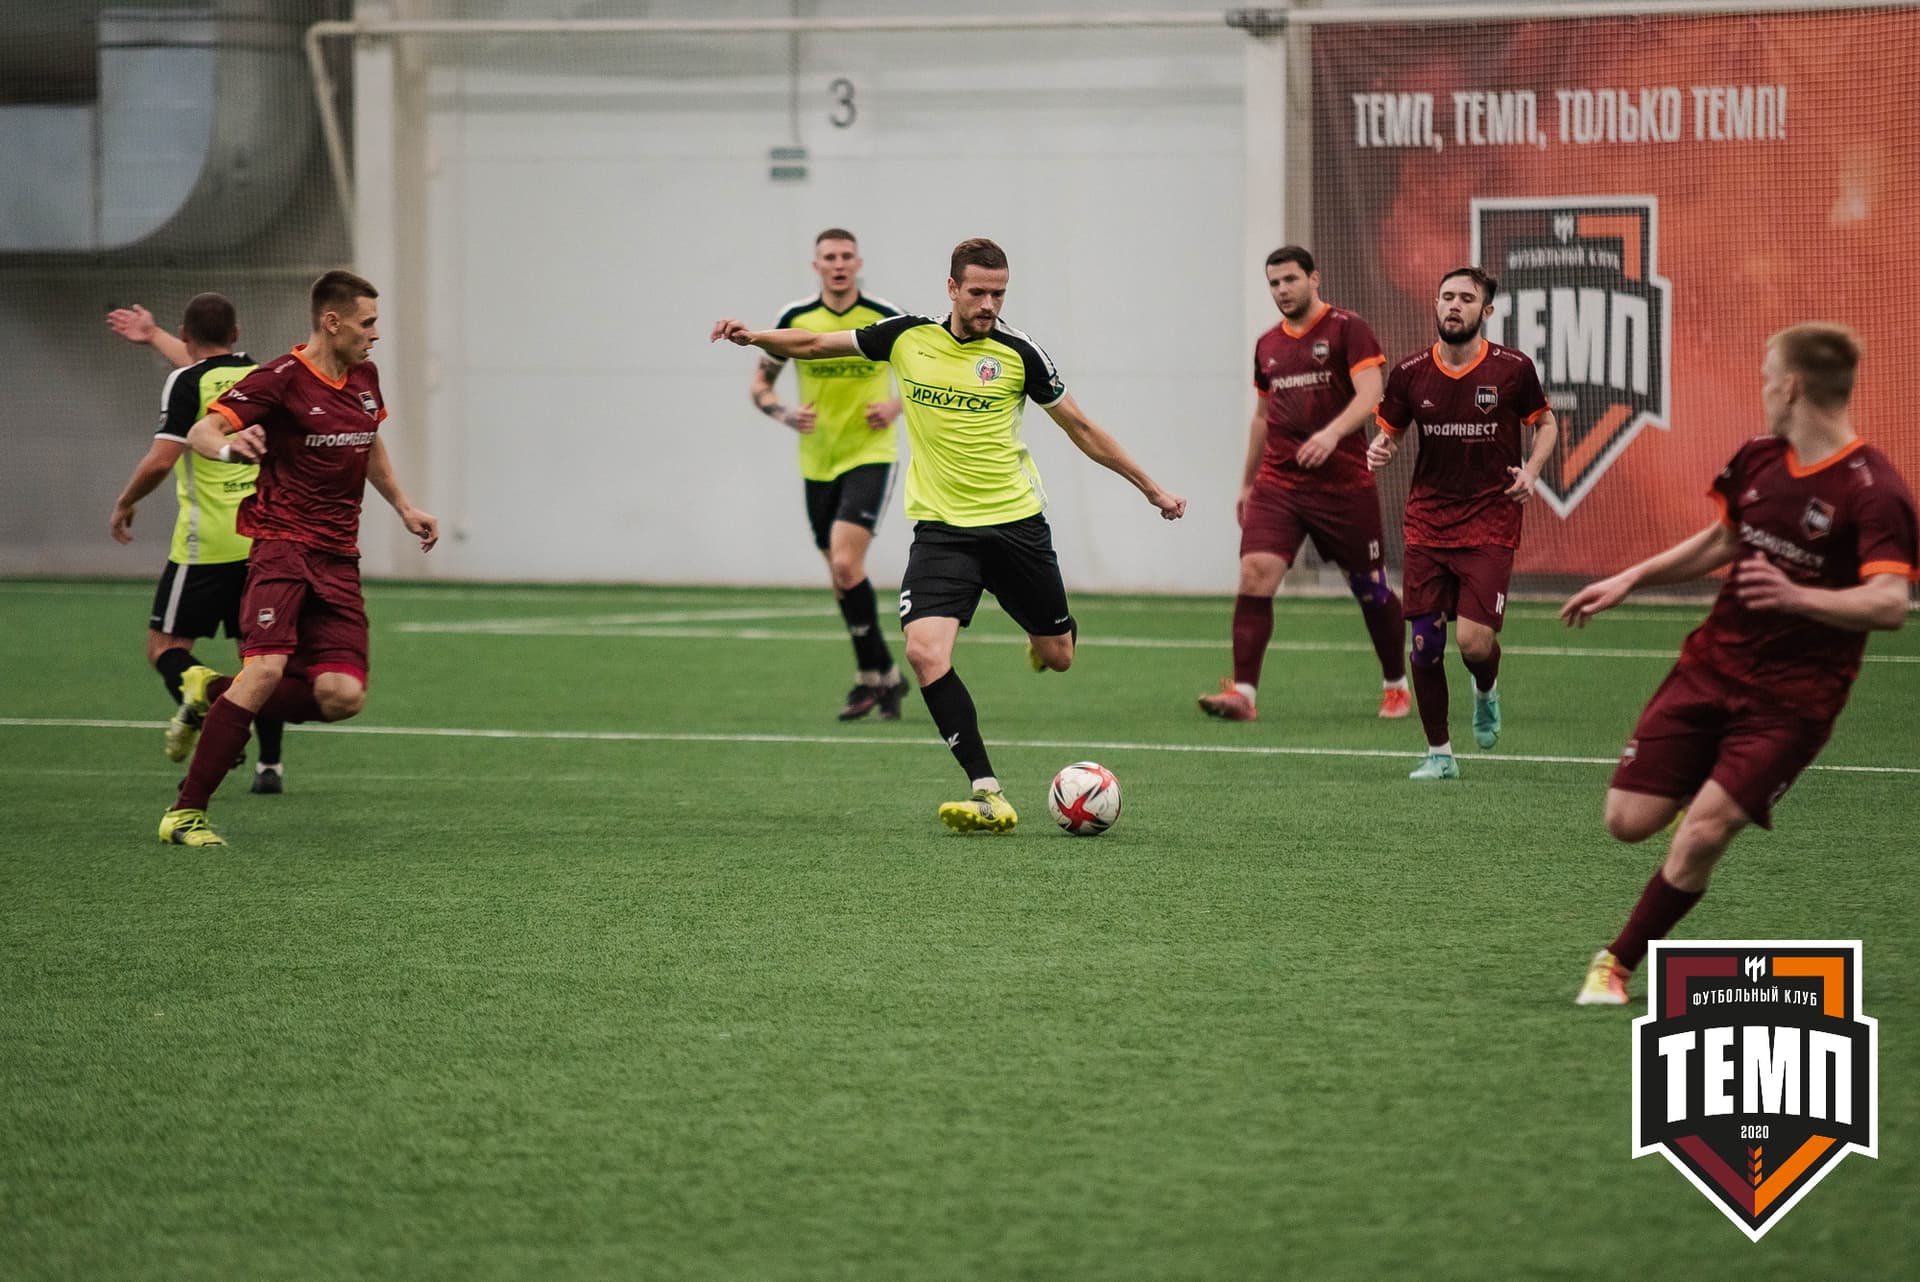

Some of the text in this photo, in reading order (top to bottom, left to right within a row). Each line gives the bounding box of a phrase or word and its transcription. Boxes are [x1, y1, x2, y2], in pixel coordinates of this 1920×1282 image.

[828, 78, 857, 129] 3
[1353, 84, 1787, 152] ТЕМП, ТЕМП, ТОЛЬКО ТЕМП!
[1486, 286, 1649, 396] ТЕМП
[912, 386, 992, 410] ИРКУТСК
[1369, 541, 1380, 560] 13
[899, 590, 913, 617] 5
